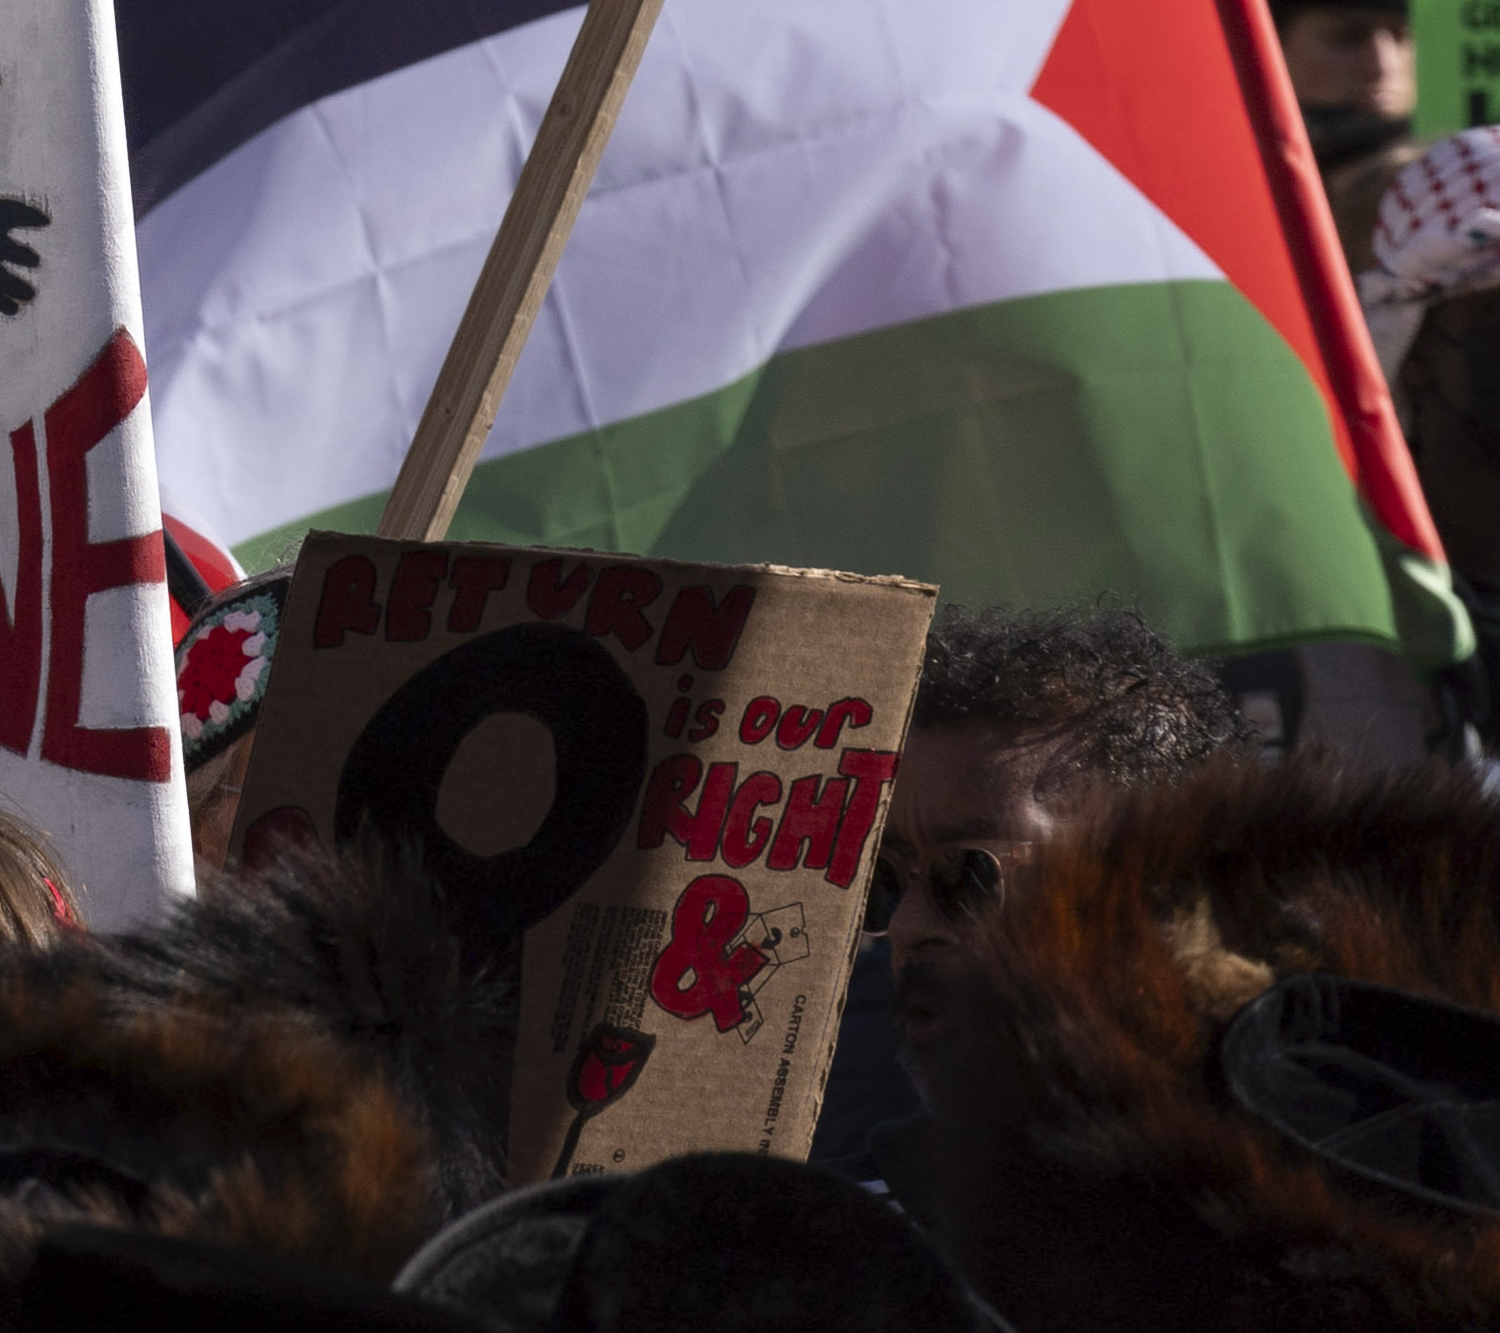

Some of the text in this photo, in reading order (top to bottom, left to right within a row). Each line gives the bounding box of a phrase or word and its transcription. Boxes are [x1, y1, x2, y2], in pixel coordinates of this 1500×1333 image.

[313, 550, 757, 671] RETURN
[637, 747, 898, 890] RIGHT
[651, 873, 770, 1034] &
[782, 994, 807, 1054] CARTON
[762, 1057, 791, 1136] ASSEMBLY
